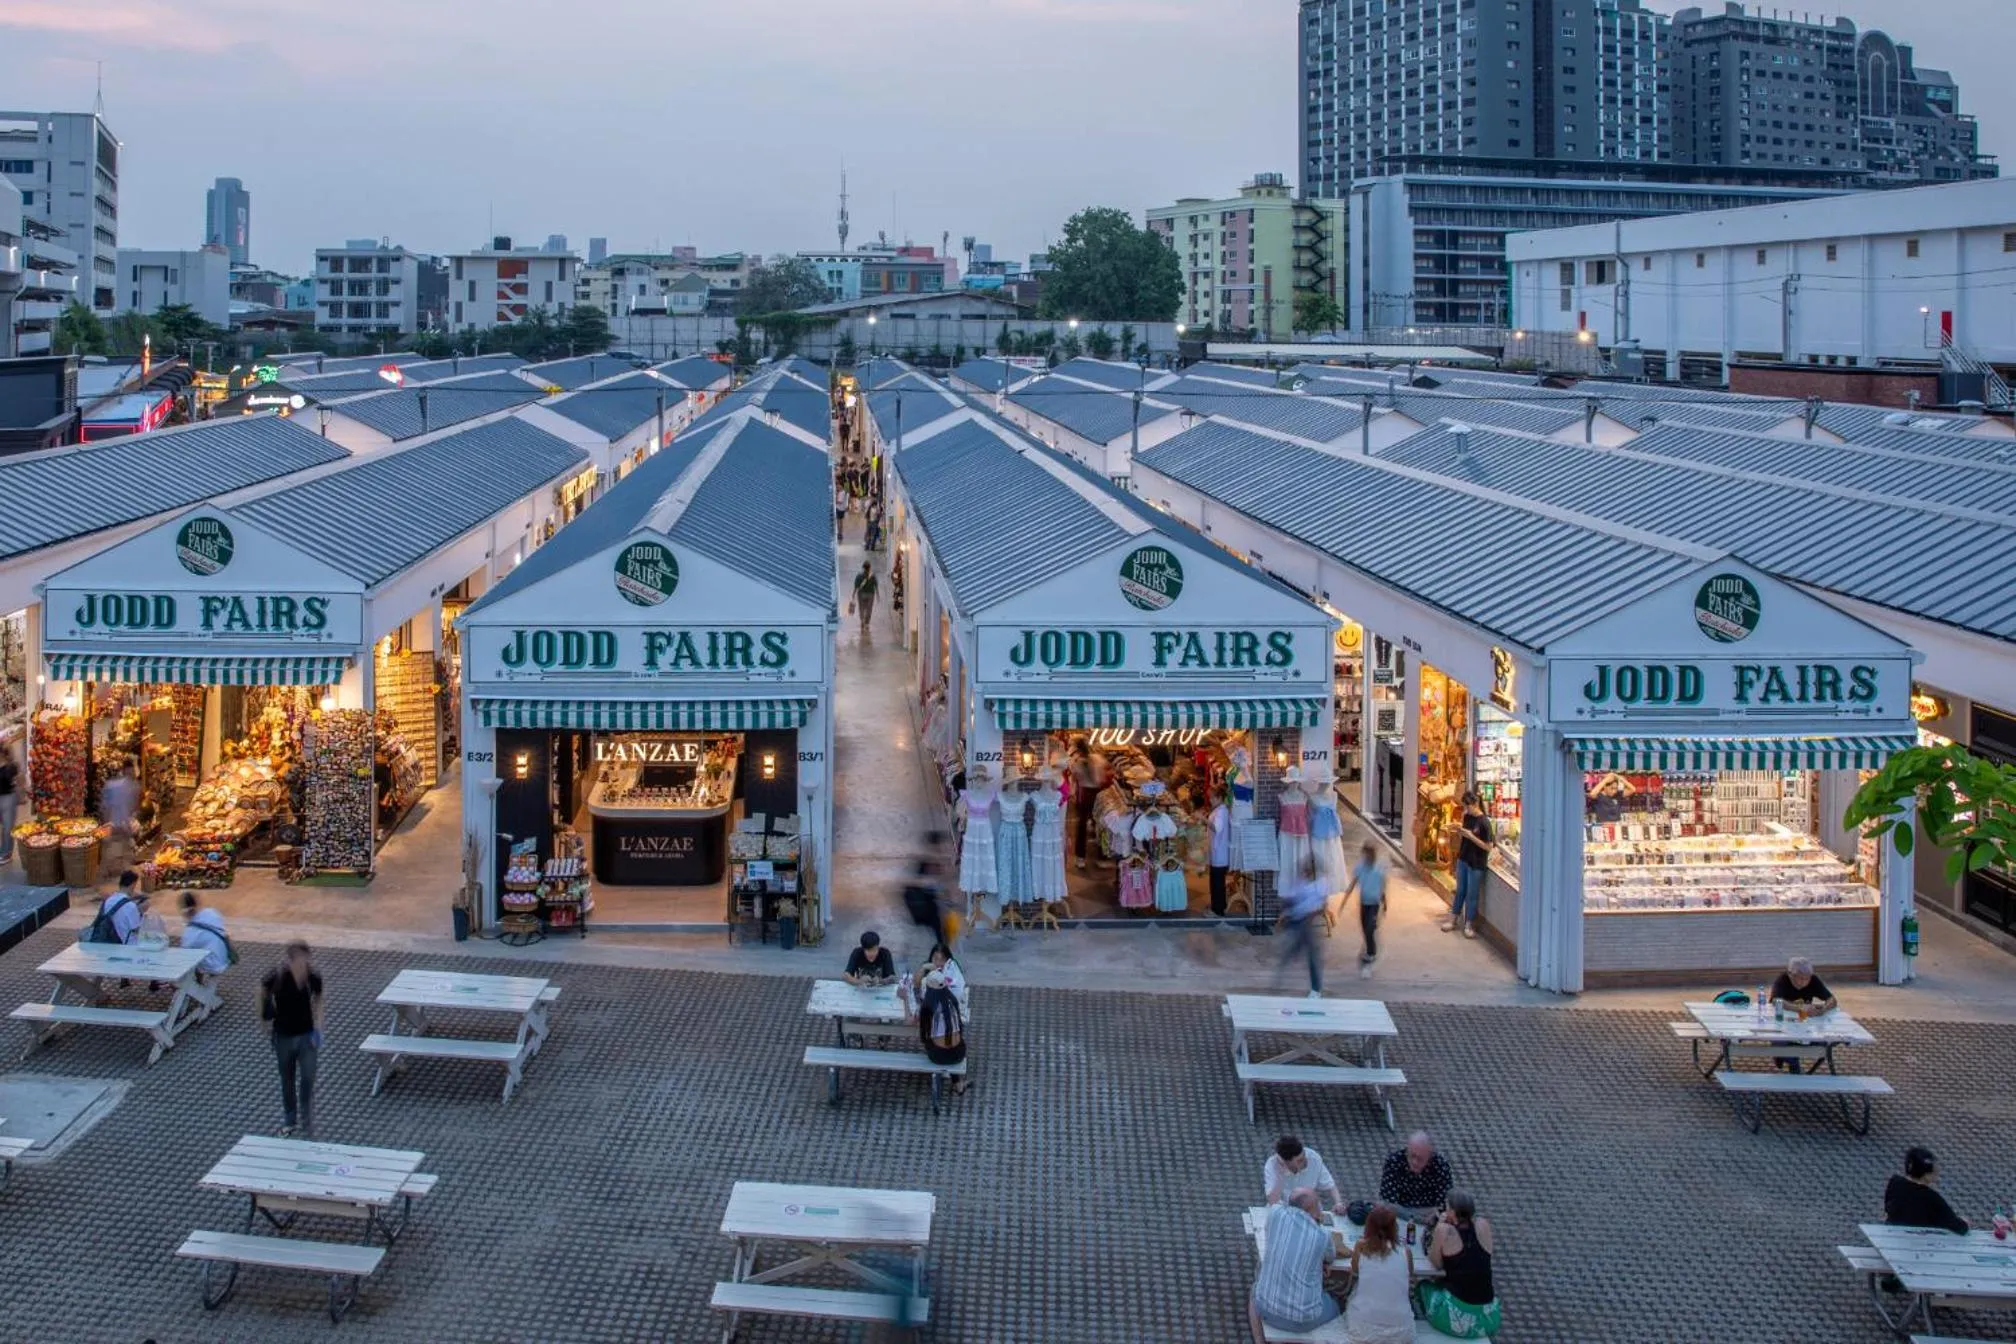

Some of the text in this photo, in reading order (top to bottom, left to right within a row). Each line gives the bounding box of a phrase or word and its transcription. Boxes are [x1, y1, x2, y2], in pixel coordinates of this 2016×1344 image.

[189, 521, 220, 534] JODD
[188, 533, 219, 560] FAIRS
[627, 546, 663, 560] JODD
[1133, 551, 1167, 564] JODD
[627, 559, 663, 589] FAIRS
[1133, 563, 1168, 593] FAIRS
[1709, 578, 1743, 593] JODD
[75, 594, 330, 631] JODD FAIRS
[1708, 592, 1744, 625] FAIRS
[501, 629, 789, 670] JODD FAIRS
[1009, 629, 1294, 669] JODD FAIRS
[1583, 664, 1879, 705] JODD FAIRS
[595, 742, 700, 763] L'ANZAE
[799, 752, 823, 762] B3/1
[976, 752, 1003, 762] B2/2
[1302, 750, 1328, 761] B2/1
[620, 836, 694, 851] L'ANZAE
